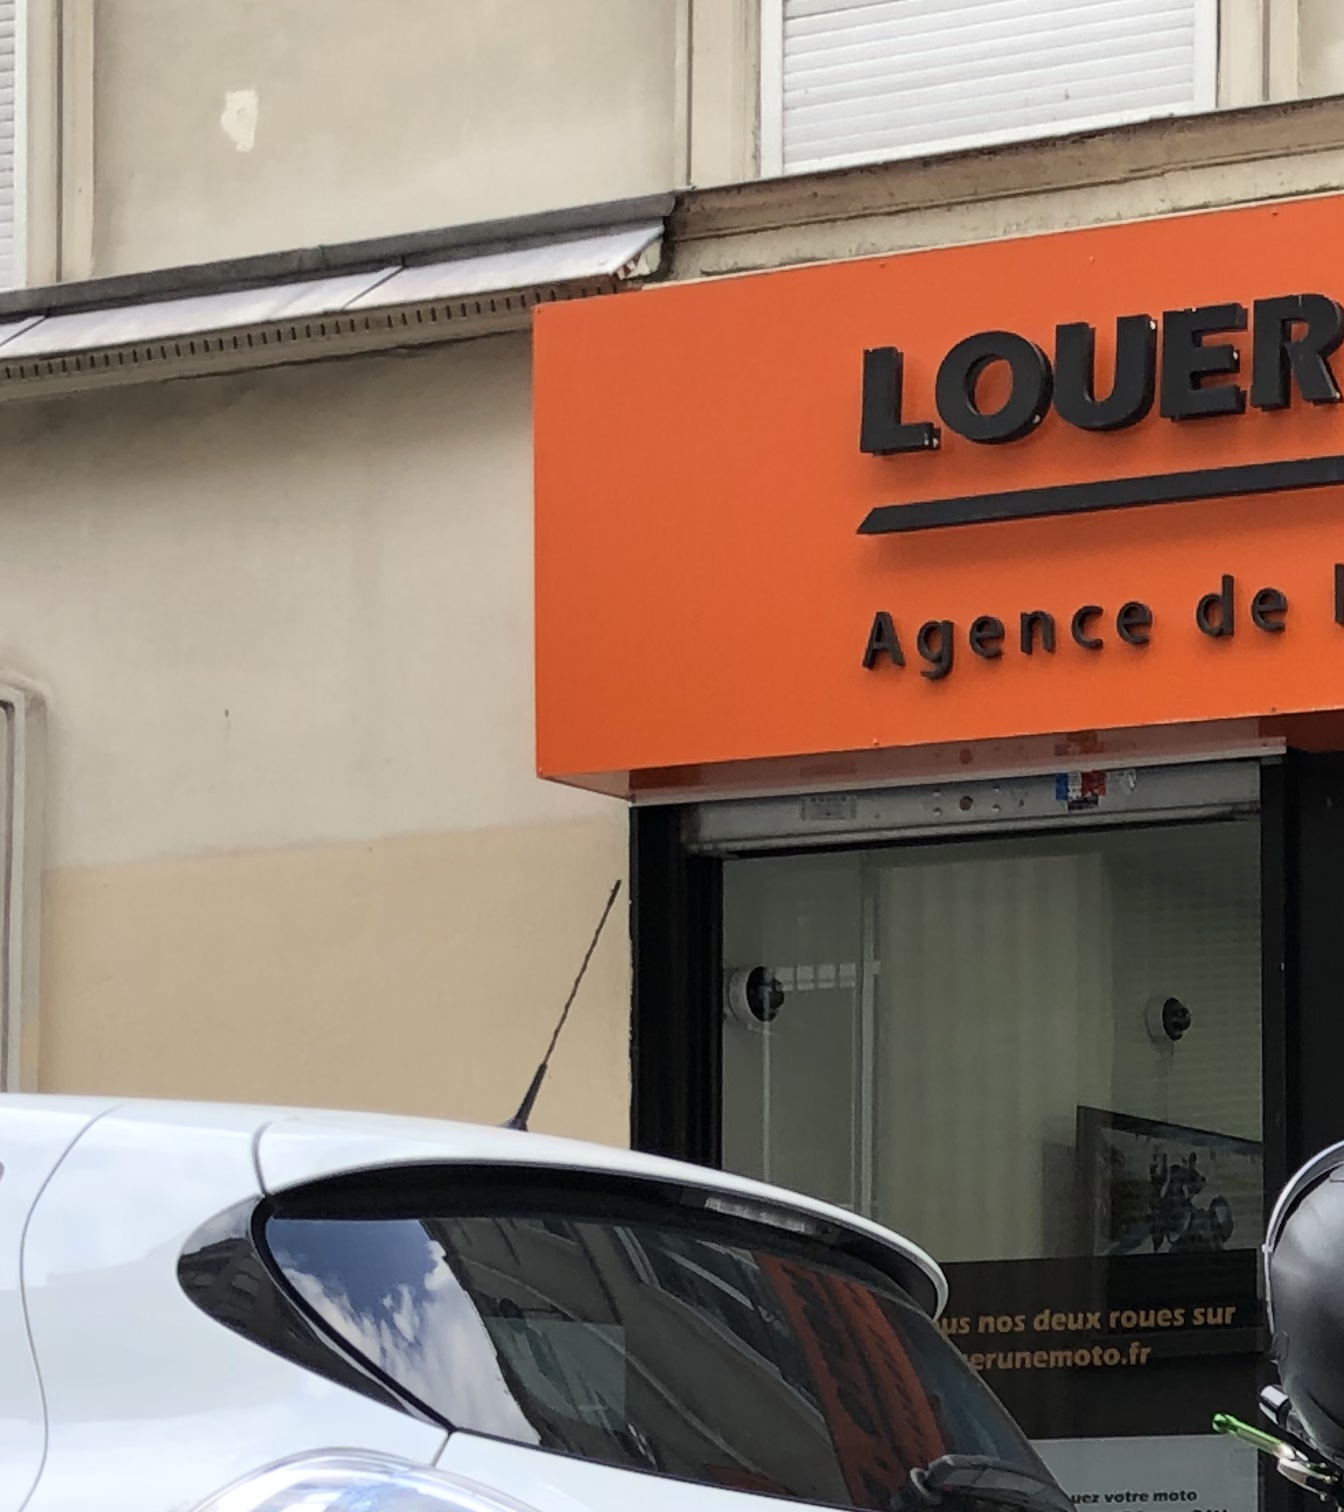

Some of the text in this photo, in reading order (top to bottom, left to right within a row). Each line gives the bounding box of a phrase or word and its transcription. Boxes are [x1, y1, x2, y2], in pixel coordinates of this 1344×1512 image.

[862, 609, 1153, 682] Agence
[1196, 574, 1289, 640] de
[977, 1313, 1026, 1334] nos
[1033, 1308, 1101, 1332] deux
[1108, 1306, 1186, 1329] roues
[1191, 1304, 1237, 1327] sur
[961, 1341, 1152, 1371] erunemoto.fr
[1104, 1490, 1150, 1504] votre
[1153, 1489, 1198, 1503] moto
